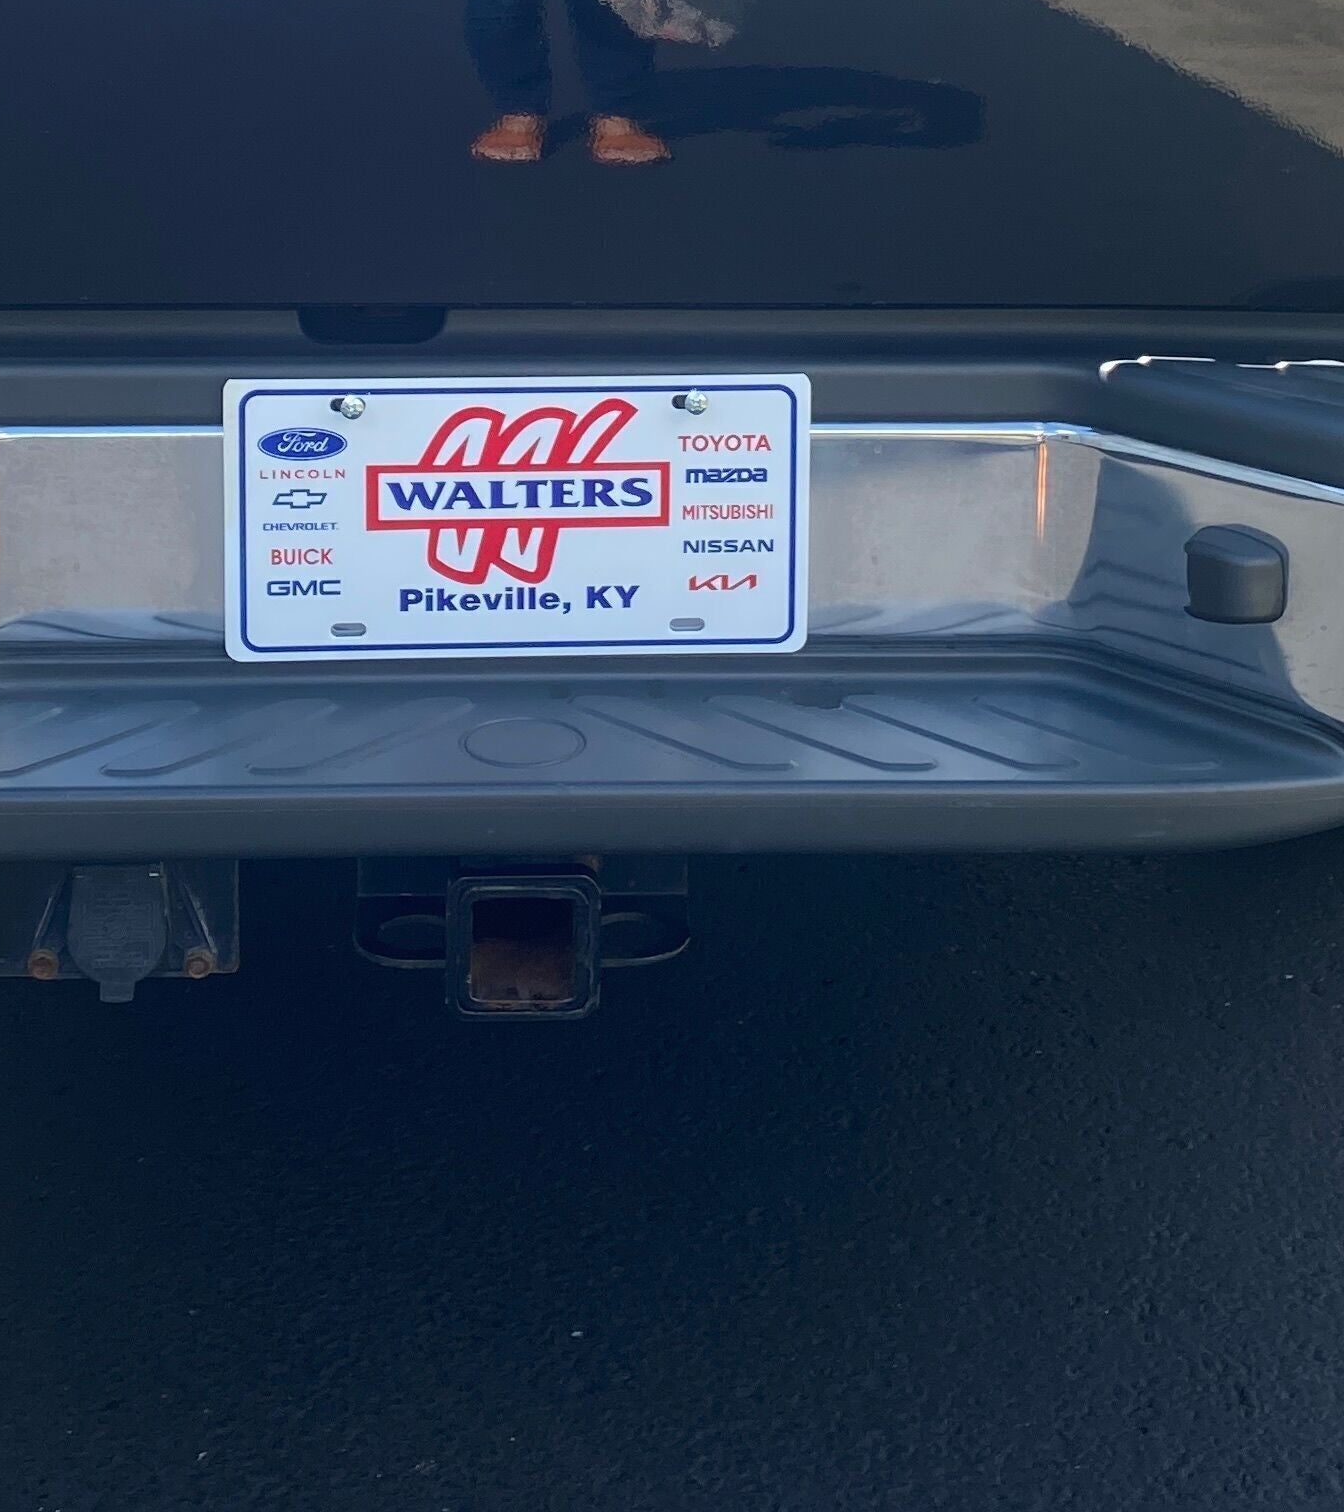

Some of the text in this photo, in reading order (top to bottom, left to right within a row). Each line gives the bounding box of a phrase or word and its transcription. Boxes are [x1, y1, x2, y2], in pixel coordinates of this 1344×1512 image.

[277, 431, 329, 453] Ford
[677, 434, 772, 452] TOYOTA
[259, 469, 346, 480] LINCOLN
[386, 477, 653, 513] WALTERS
[682, 504, 774, 521] MITSUBISHI
[263, 522, 338, 531] CHEVROLET
[683, 538, 774, 554] NISSAN
[271, 548, 333, 565] BUICK
[267, 580, 341, 596] GMC
[399, 585, 640, 615] Pikeville, KY
